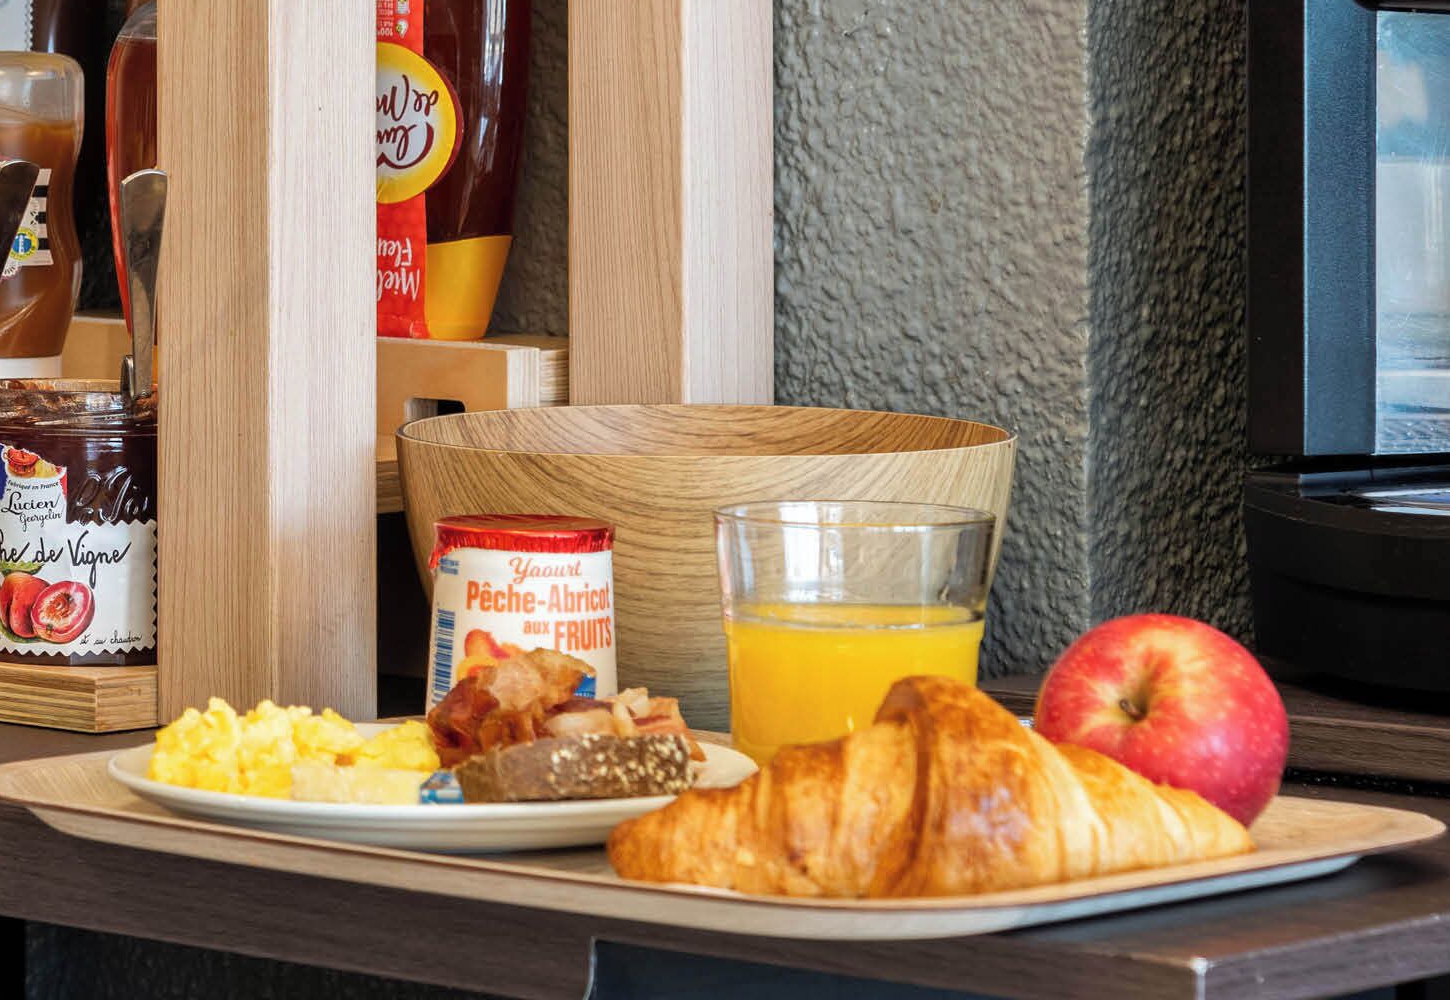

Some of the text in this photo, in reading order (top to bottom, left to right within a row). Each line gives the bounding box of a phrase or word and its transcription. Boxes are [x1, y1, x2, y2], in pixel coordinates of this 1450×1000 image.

[0, 491, 61, 516] Lucien
[19, 508, 63, 532] Georgelin
[32, 536, 64, 563] de
[67, 529, 132, 589] Vigne
[507, 556, 583, 585] Yaourt
[466, 579, 611, 615] Pêche-Abricot
[522, 616, 613, 651] aux FRUITS
